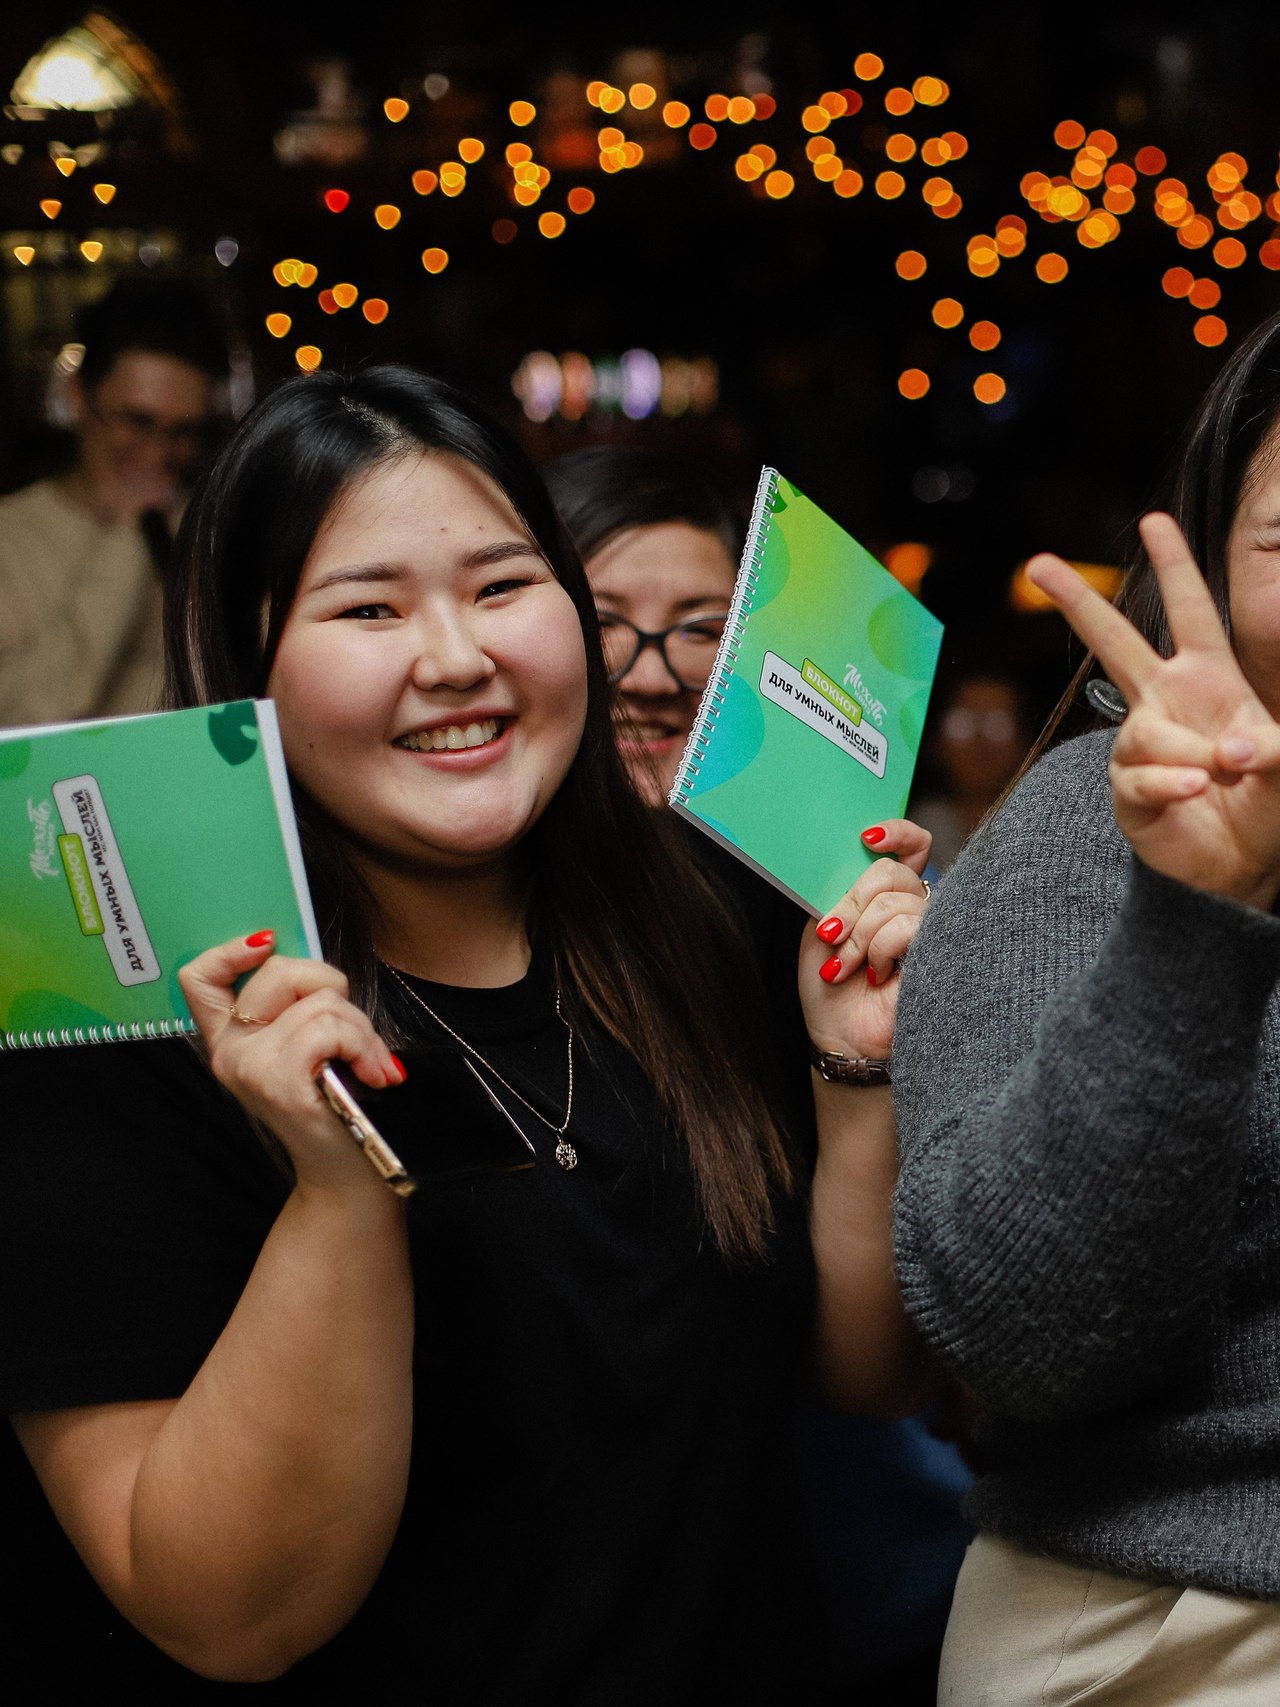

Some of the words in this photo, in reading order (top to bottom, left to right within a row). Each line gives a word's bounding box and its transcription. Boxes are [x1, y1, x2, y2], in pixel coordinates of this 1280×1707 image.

[768, 672, 793, 696] ДЛЯ
[795, 689, 835, 726] УМНЫХ
[836, 719, 880, 760] МЫСЛЕЙ
[806, 666, 859, 718] БЛОКНОТ
[70, 789, 106, 867] МЫСЛЕЙ
[64, 841, 98, 929] БЛОКНОТ
[98, 869, 129, 935] УМНЫХ
[121, 937, 145, 972] ДЛЯ
